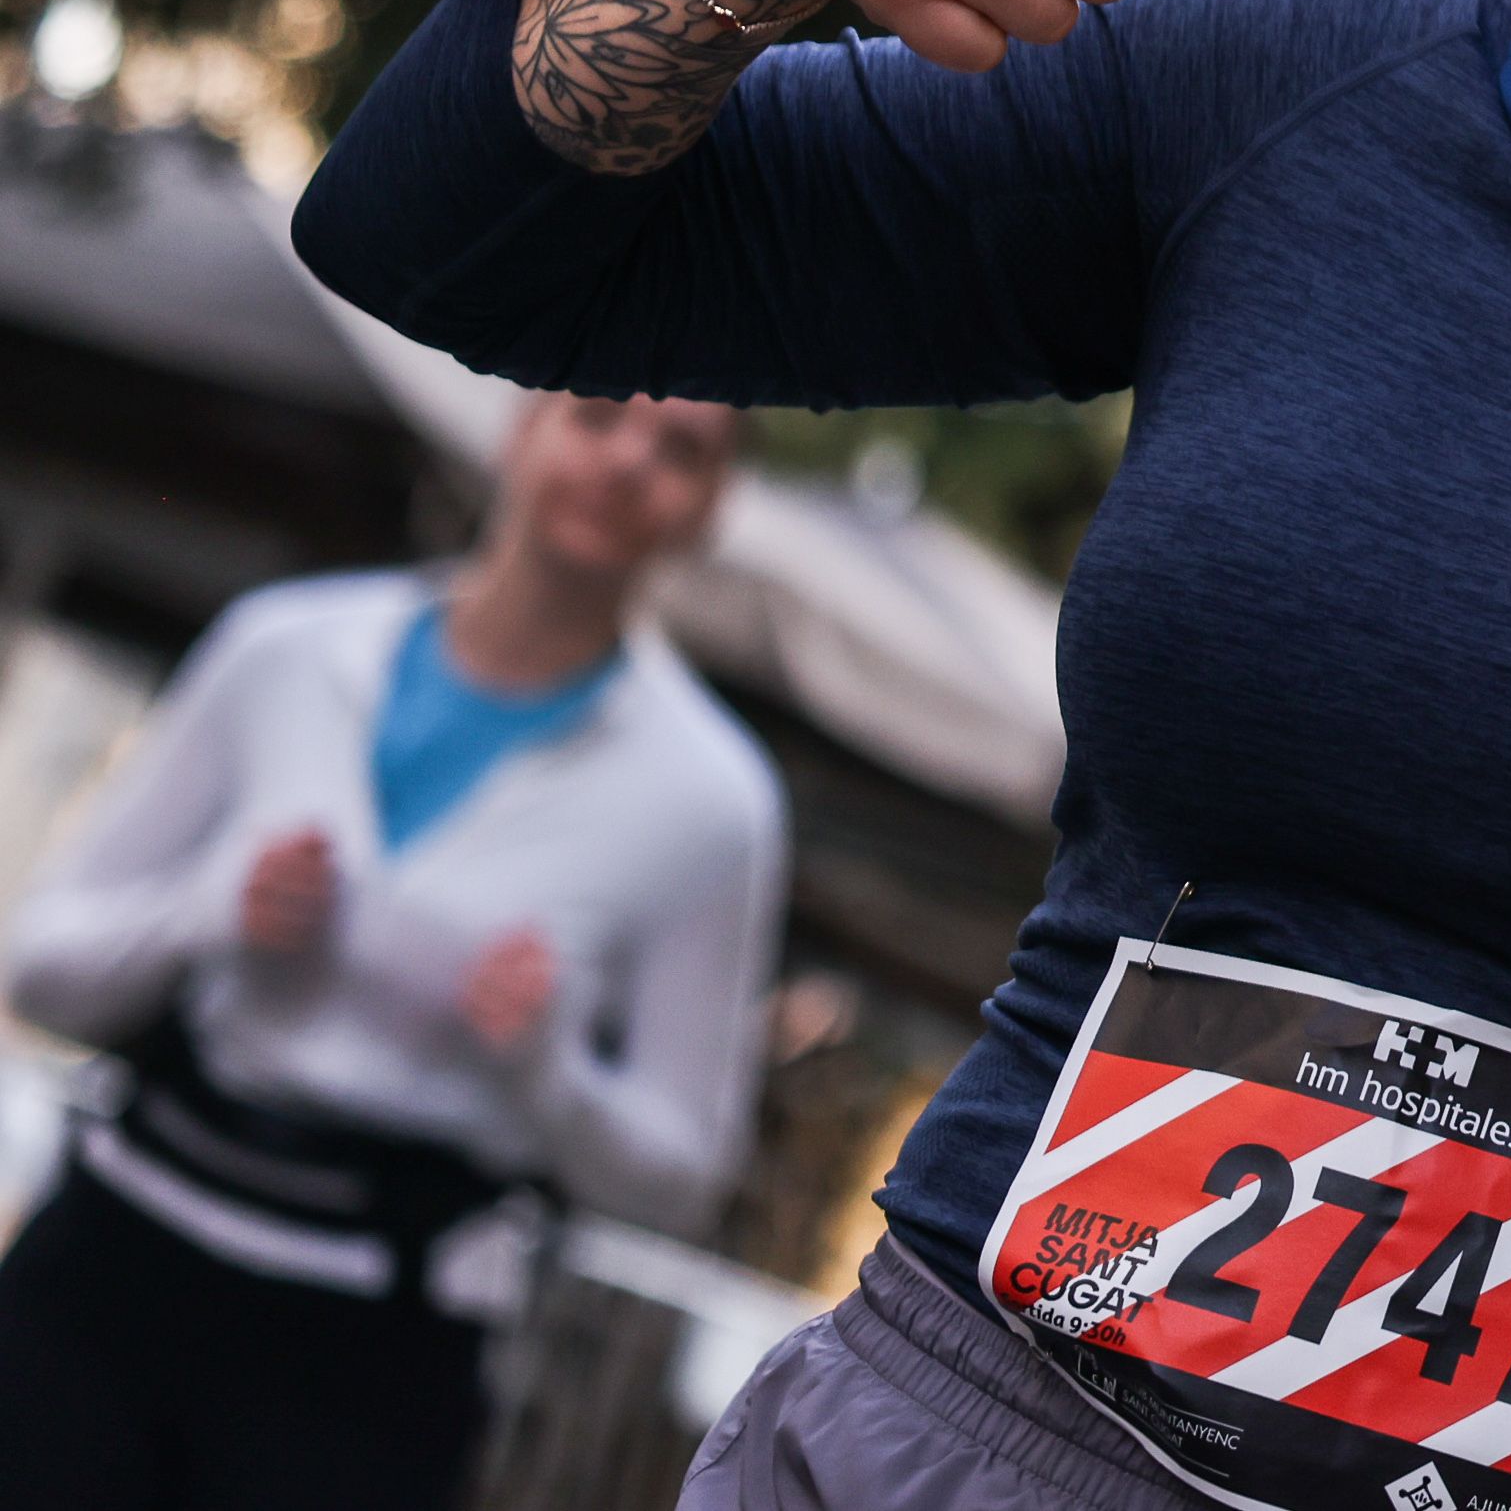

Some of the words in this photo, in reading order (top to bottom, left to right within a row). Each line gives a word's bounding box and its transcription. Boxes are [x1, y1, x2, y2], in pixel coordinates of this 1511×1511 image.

[1295, 1051, 1349, 1096] hm
[1044, 1203, 1160, 1258] MITJA
[1036, 1234, 1149, 1286] SANT
[1010, 1262, 1154, 1324] CUGAT
[1069, 1315, 1127, 1346] 9:30h
